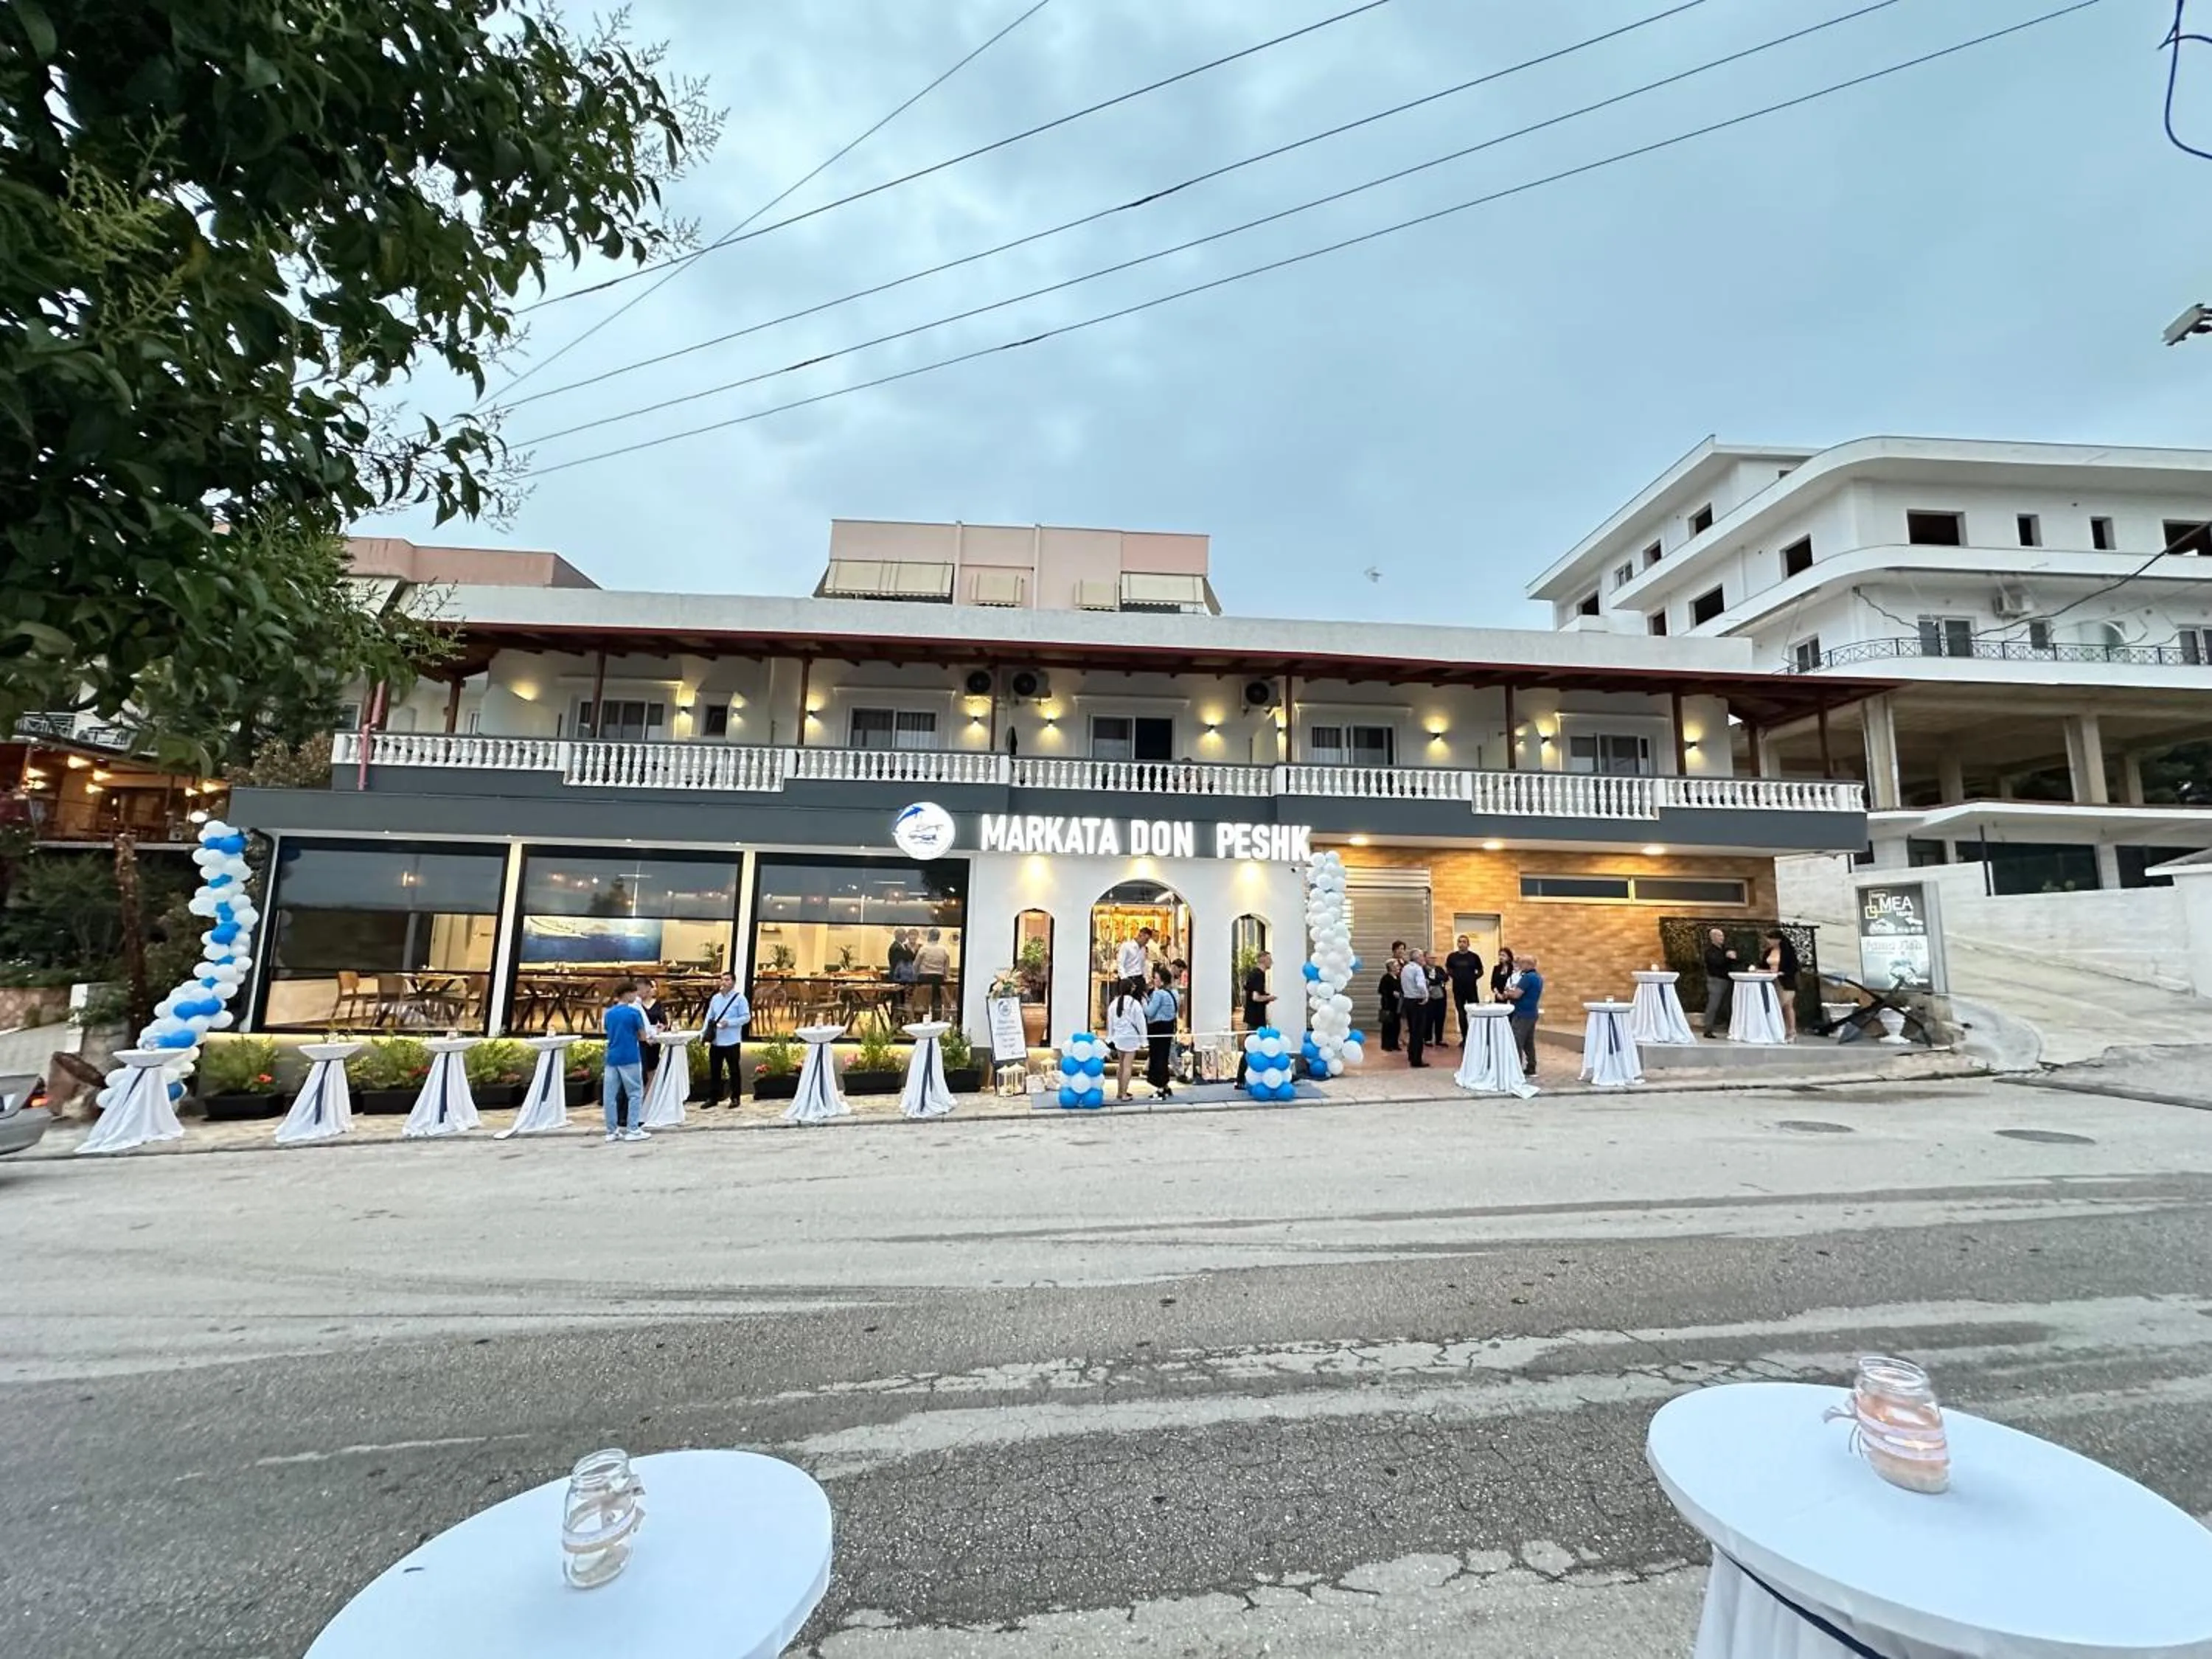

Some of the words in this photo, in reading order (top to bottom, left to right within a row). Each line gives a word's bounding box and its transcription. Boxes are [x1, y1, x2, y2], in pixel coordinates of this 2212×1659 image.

[981, 813, 1120, 855] MARKATA
[1130, 819, 1194, 858] DON
[1217, 822, 1312, 862] PESHK
